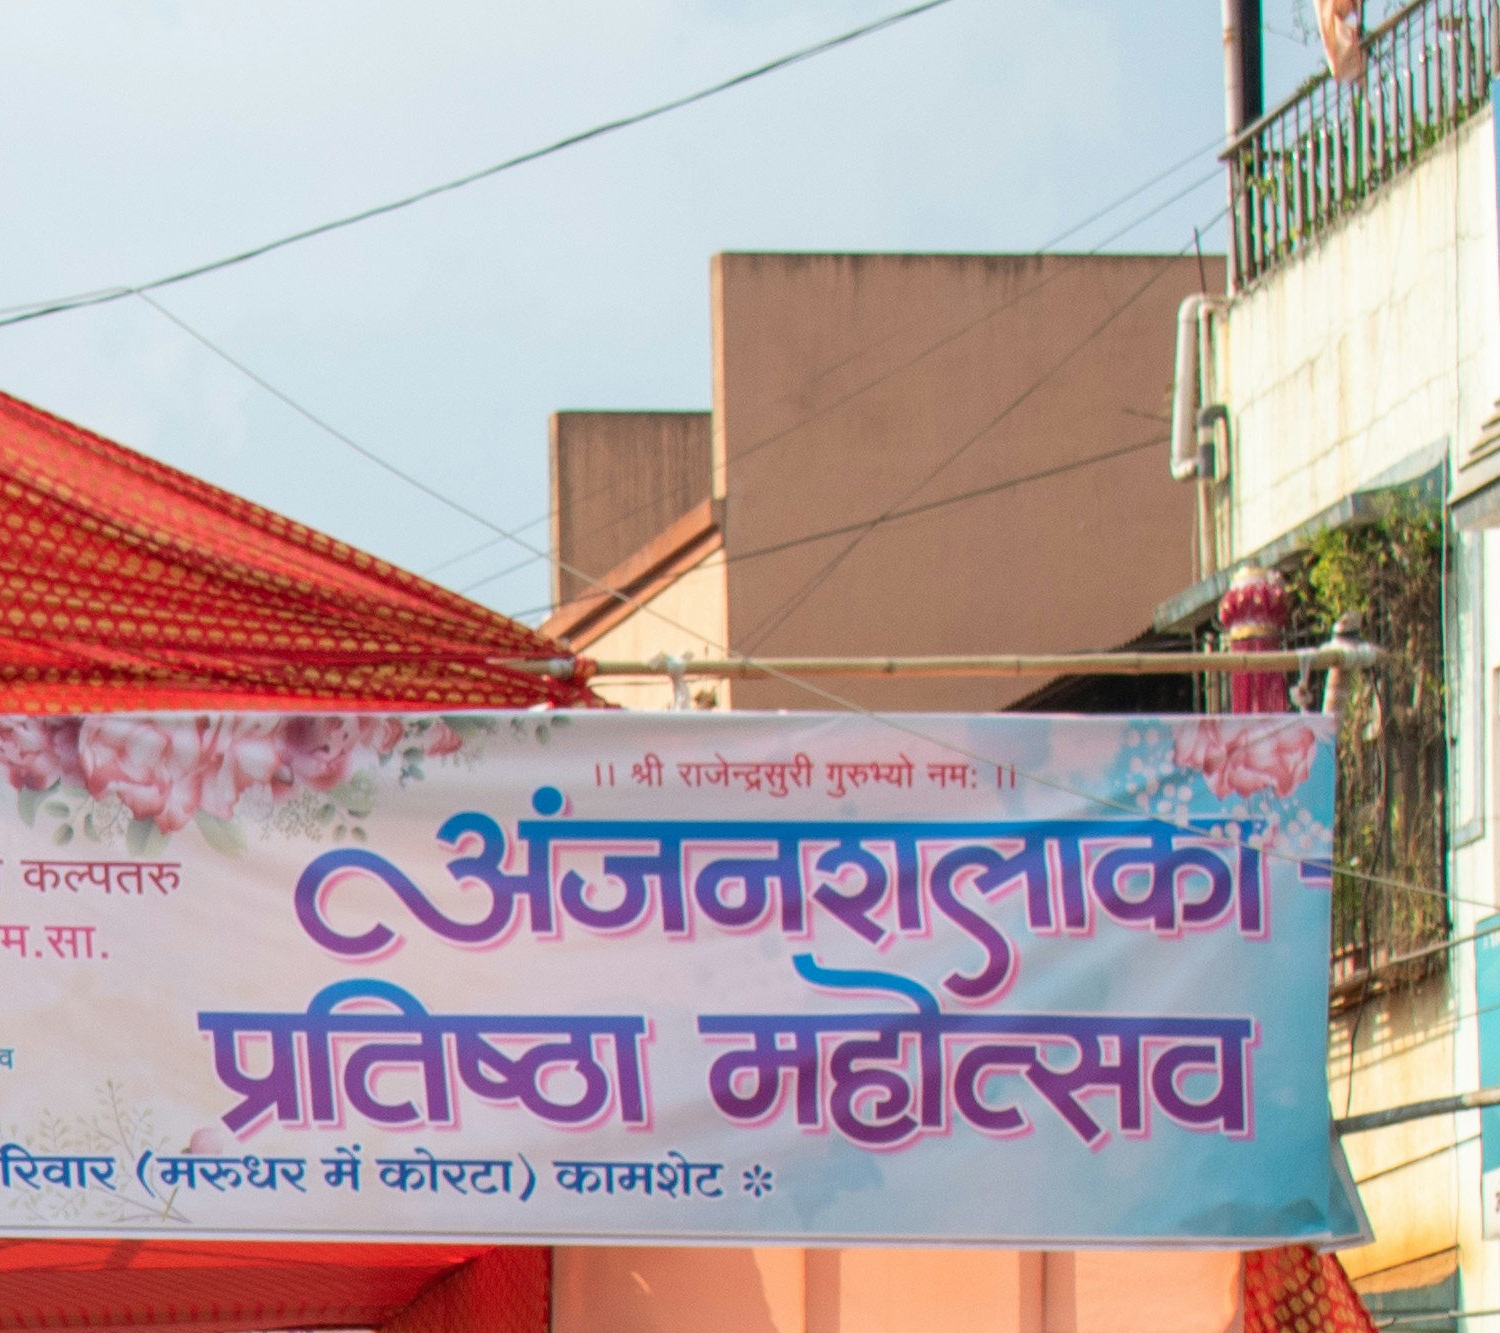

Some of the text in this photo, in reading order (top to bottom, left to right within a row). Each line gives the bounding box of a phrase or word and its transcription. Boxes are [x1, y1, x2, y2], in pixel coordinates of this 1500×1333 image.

[630, 753, 664, 788] श्री
[20, 855, 182, 899] कल्पतरु
[0, 922, 111, 961] म.सा.
[197, 952, 1258, 1148] प्रतिष्ठा महोत्सव
[321, 1144, 362, 1194] में
[554, 1152, 725, 1199] कामशेट
